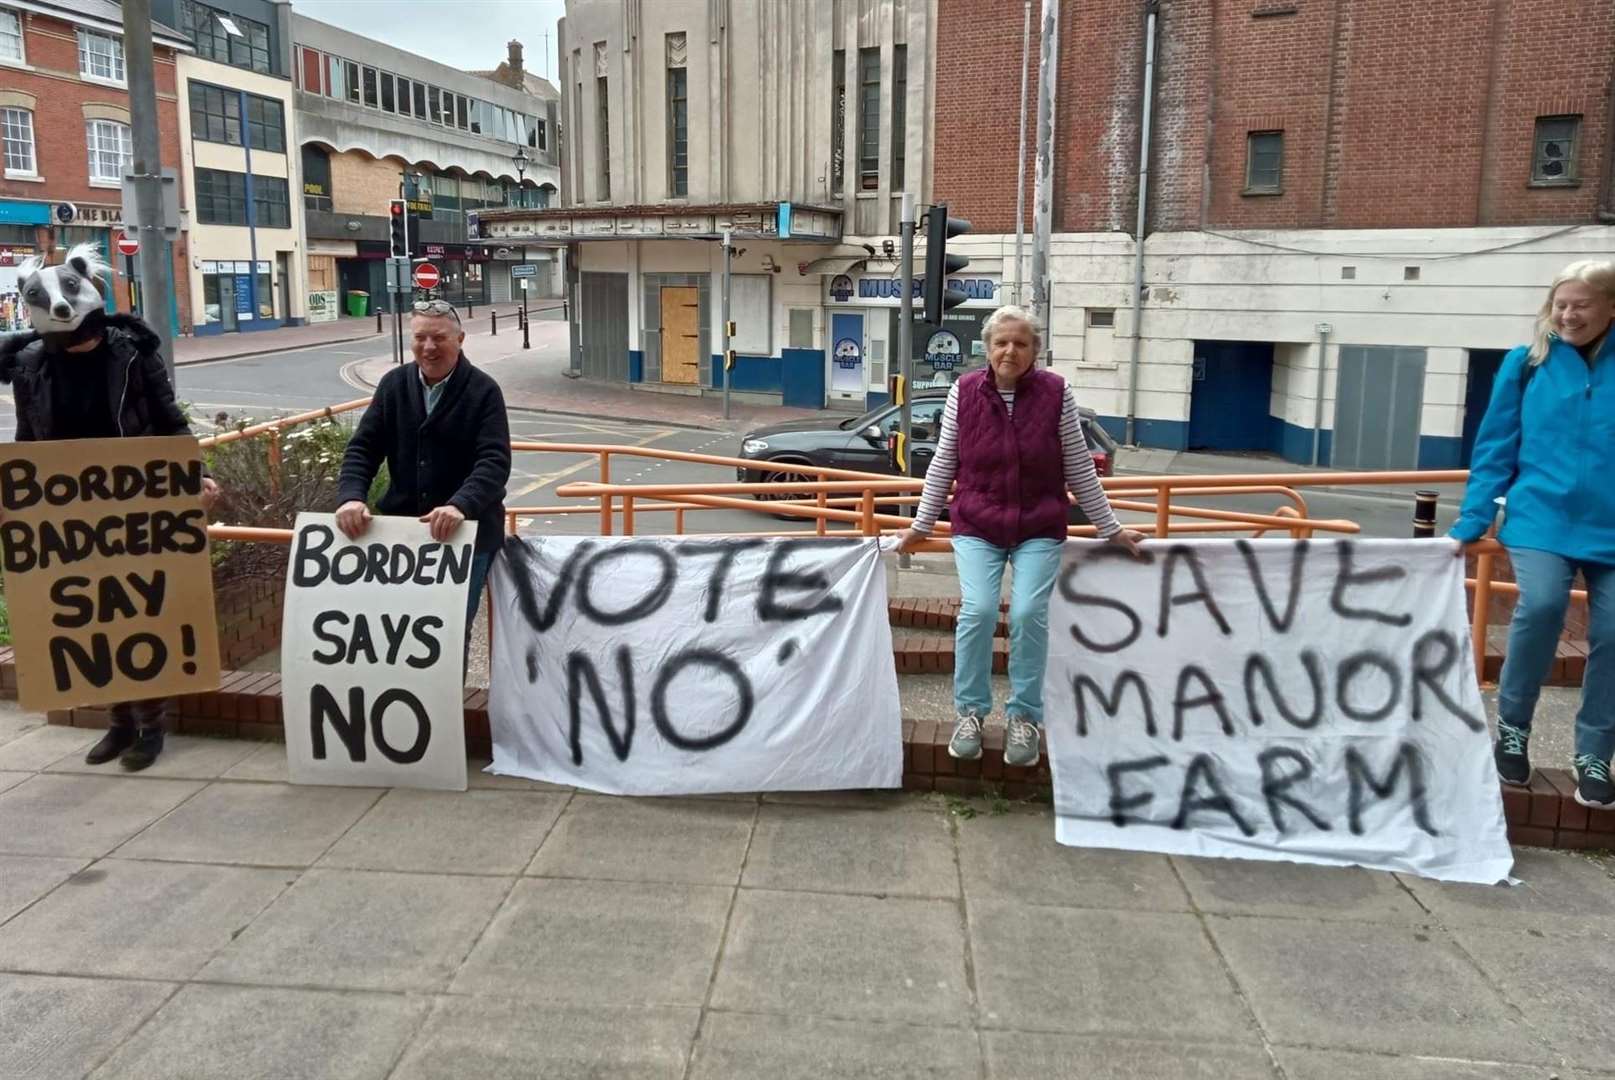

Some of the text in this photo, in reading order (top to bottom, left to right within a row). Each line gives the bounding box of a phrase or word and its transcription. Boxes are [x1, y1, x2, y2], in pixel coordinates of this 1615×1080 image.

[947, 279, 993, 299] BAR
[924, 353, 962, 361] MUSCLE
[933, 361, 953, 369] BAR
[0, 458, 206, 510] BORDEN
[0, 509, 207, 573] BADGERS
[293, 524, 472, 587] BORDEN
[50, 570, 166, 628] SAY
[502, 535, 864, 632] VOTE
[1058, 538, 1413, 652] SAVE
[50, 624, 197, 692] NO!
[312, 610, 444, 669] SAYS
[1073, 629, 1485, 742] MANOR
[310, 684, 431, 764] NO
[1106, 743, 1438, 837] FARM
